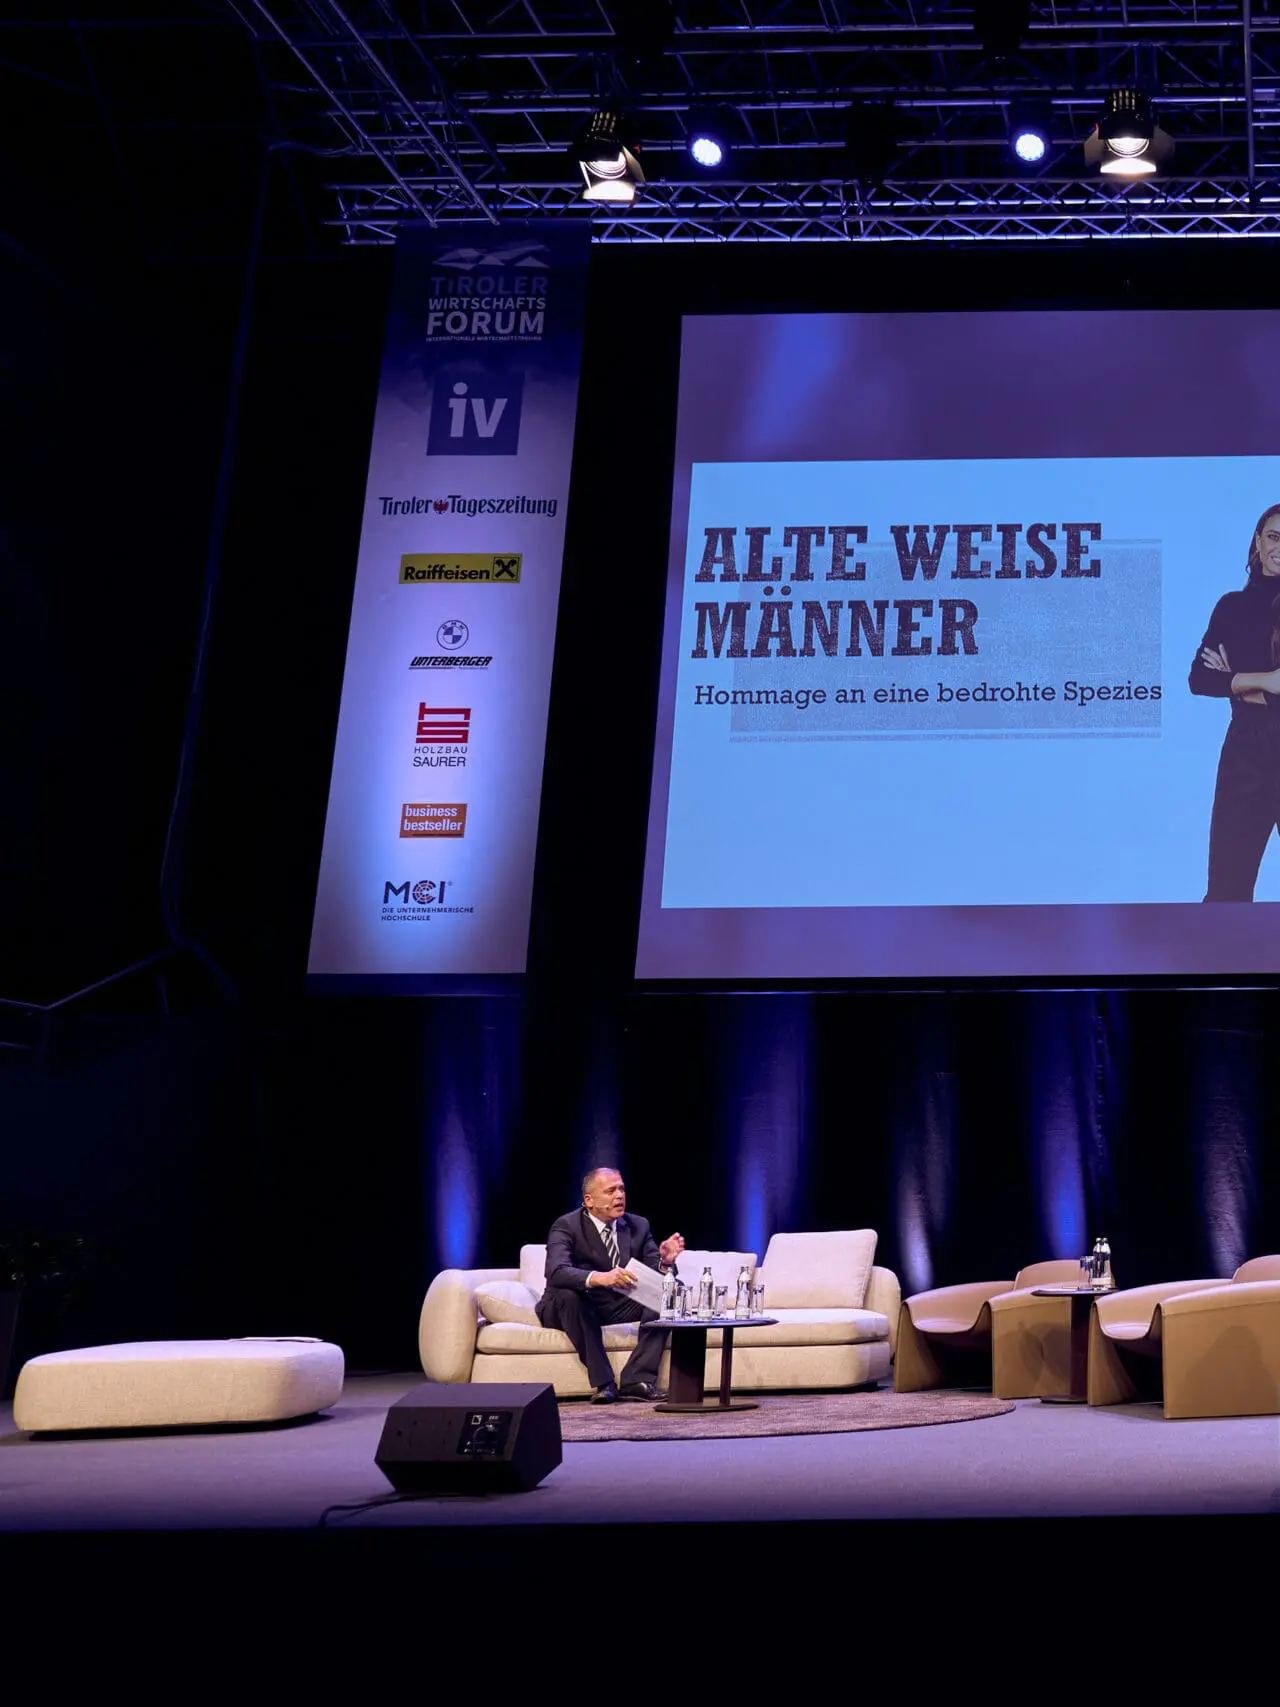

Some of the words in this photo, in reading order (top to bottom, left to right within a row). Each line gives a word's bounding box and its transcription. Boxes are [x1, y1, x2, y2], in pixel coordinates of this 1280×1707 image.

[429, 297, 546, 310] WIRTSCHAFTS
[427, 311, 544, 335] FORUM
[449, 382, 508, 438] iv
[379, 496, 433, 515] Tiroler
[448, 495, 558, 517] Tageszeitung
[694, 525, 868, 582] ALTE
[890, 522, 1102, 581] WEISE
[404, 564, 490, 580] Raiffeisen
[691, 585, 979, 658] MÄNNER
[694, 685, 826, 709] Hommage
[835, 688, 865, 703] an
[873, 683, 929, 703] eine
[936, 681, 1056, 702] bedrohte
[1064, 680, 1162, 706] Spezies
[414, 746, 468, 754] HOLZBAU
[413, 756, 466, 767] SAURER
[405, 805, 458, 817] business
[403, 819, 462, 831] bestseller
